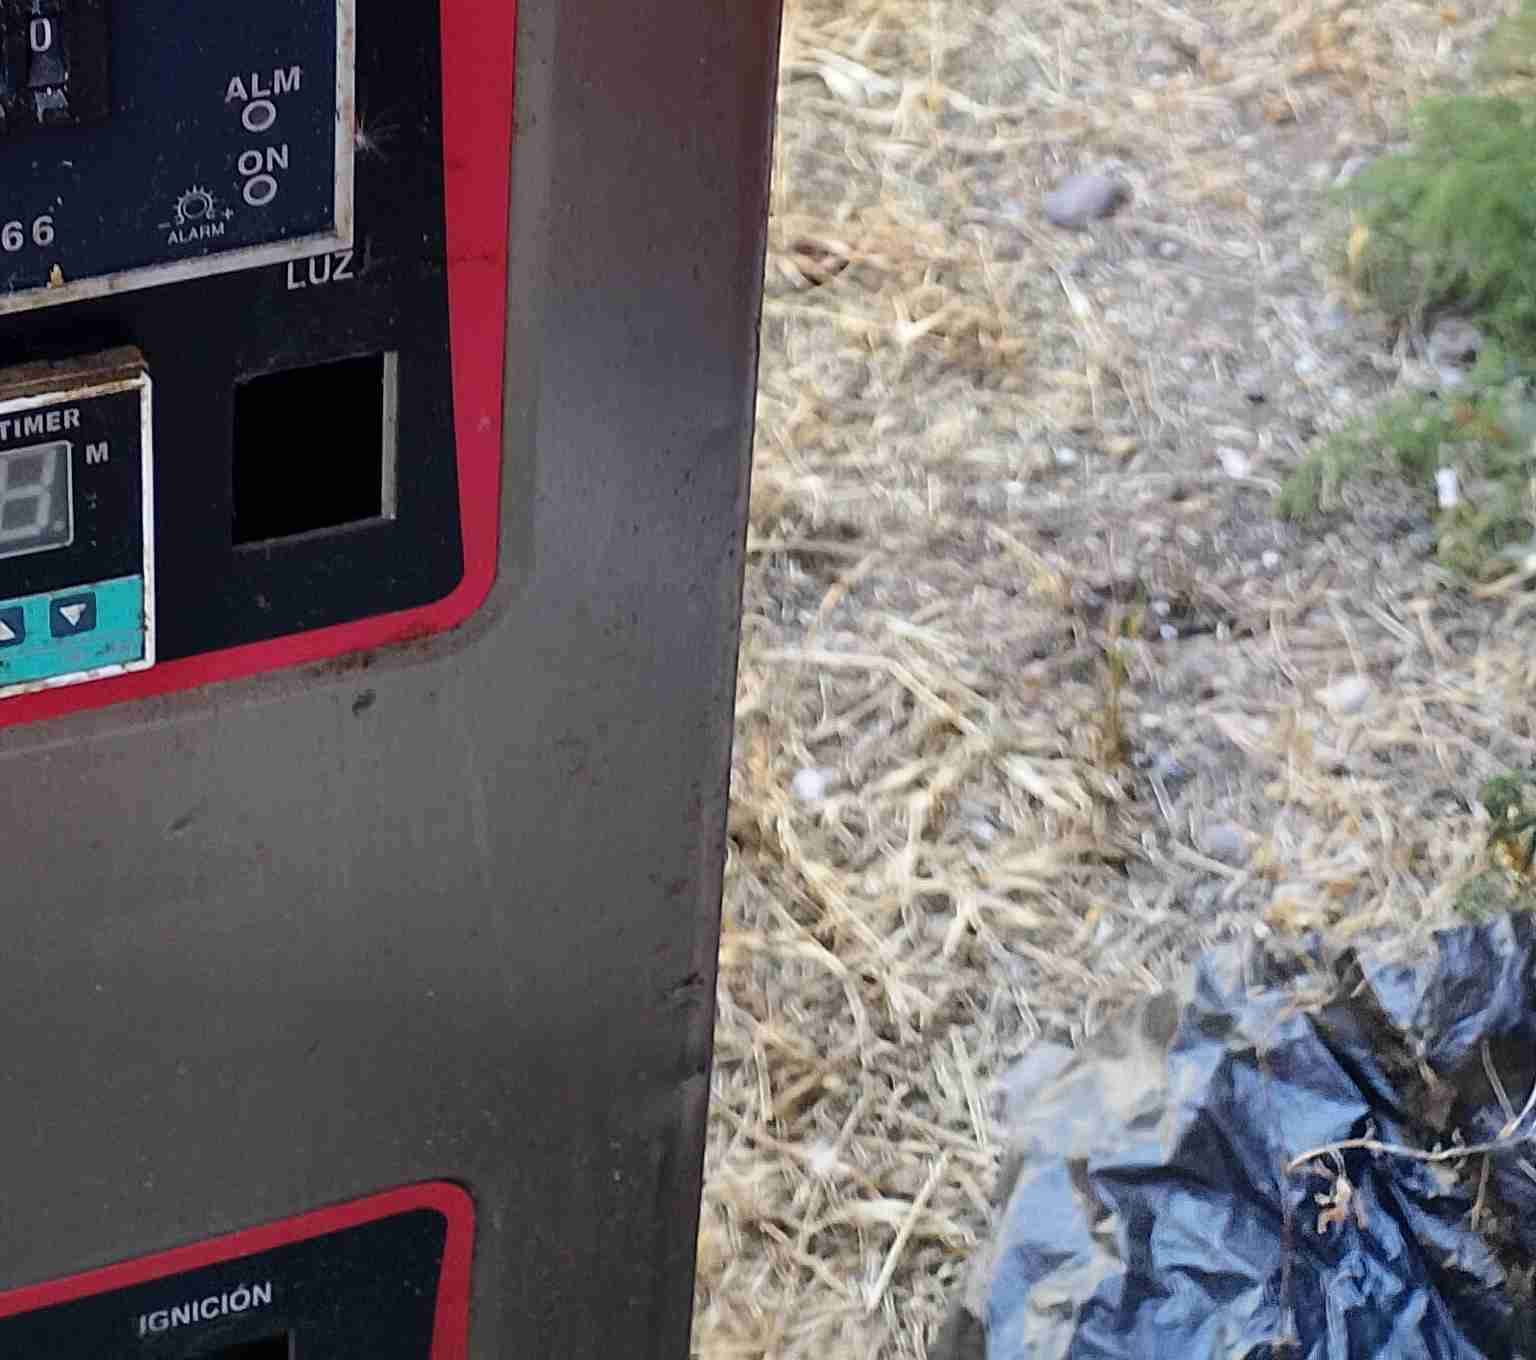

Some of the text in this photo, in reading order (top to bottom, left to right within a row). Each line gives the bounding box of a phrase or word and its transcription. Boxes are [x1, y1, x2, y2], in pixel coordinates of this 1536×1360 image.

[222, 64, 302, 99] ALM
[235, 142, 291, 176] ON
[165, 220, 227, 245] ALARM
[286, 250, 354, 290] LUZ
[84, 440, 110, 465] M
[138, 1281, 274, 1337] IGNICIÓN
